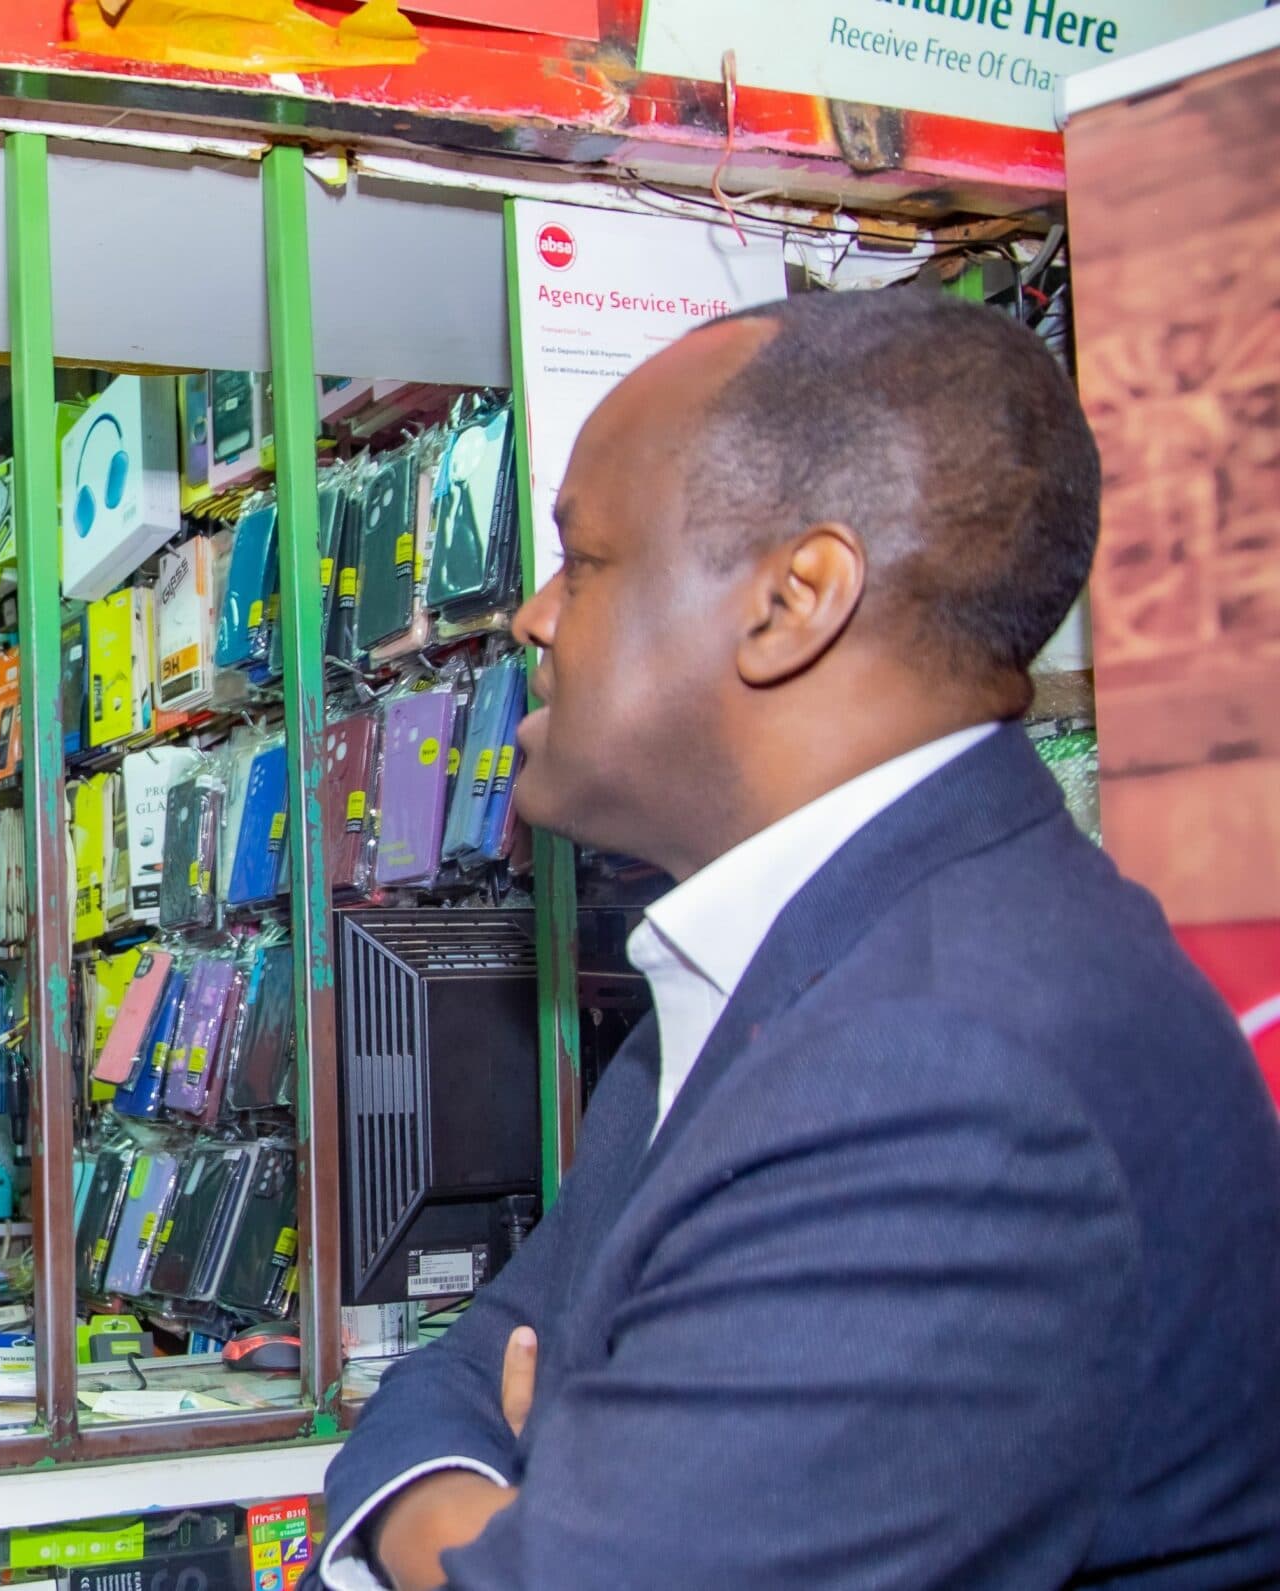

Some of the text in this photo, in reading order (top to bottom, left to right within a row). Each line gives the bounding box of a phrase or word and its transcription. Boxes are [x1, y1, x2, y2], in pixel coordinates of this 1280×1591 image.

[1024, 0, 1118, 53] Here
[829, 16, 1059, 91] Receive Free Of Cha
[540, 235, 573, 255] absa
[538, 284, 605, 312] Agency
[609, 291, 677, 314] Service
[135, 802, 167, 815] GLA
